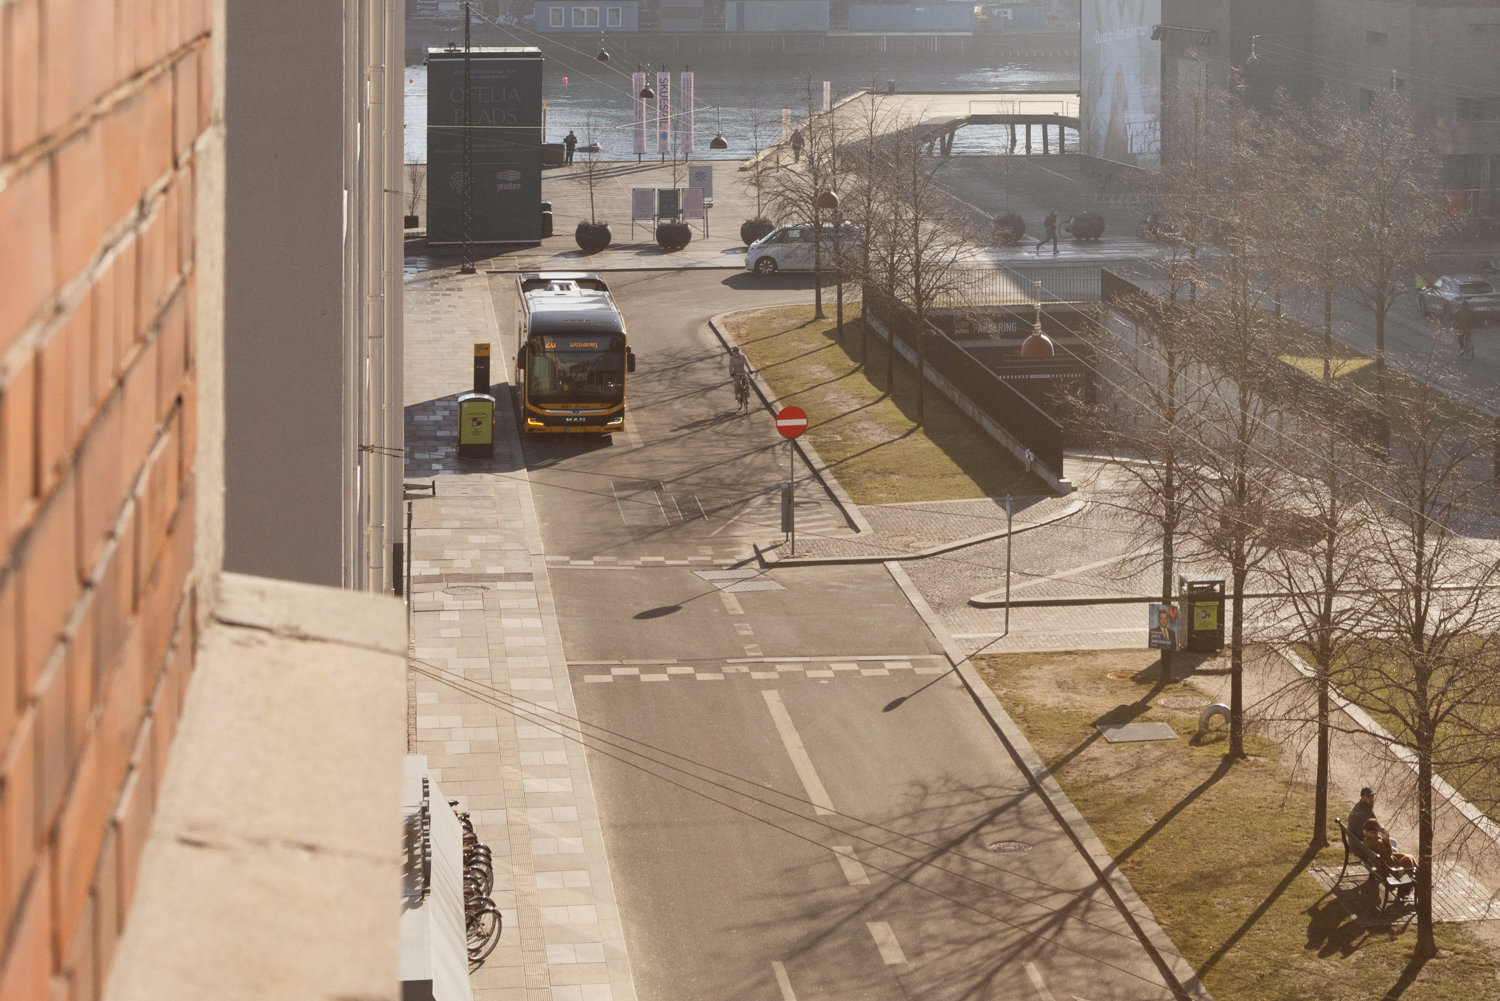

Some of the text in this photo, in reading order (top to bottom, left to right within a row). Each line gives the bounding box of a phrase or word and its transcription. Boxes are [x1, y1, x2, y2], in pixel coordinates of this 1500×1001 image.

[659, 77, 669, 127] SKUESPIL
[496, 182, 521, 192] jeudan
[1169, 607, 1177, 619] V
